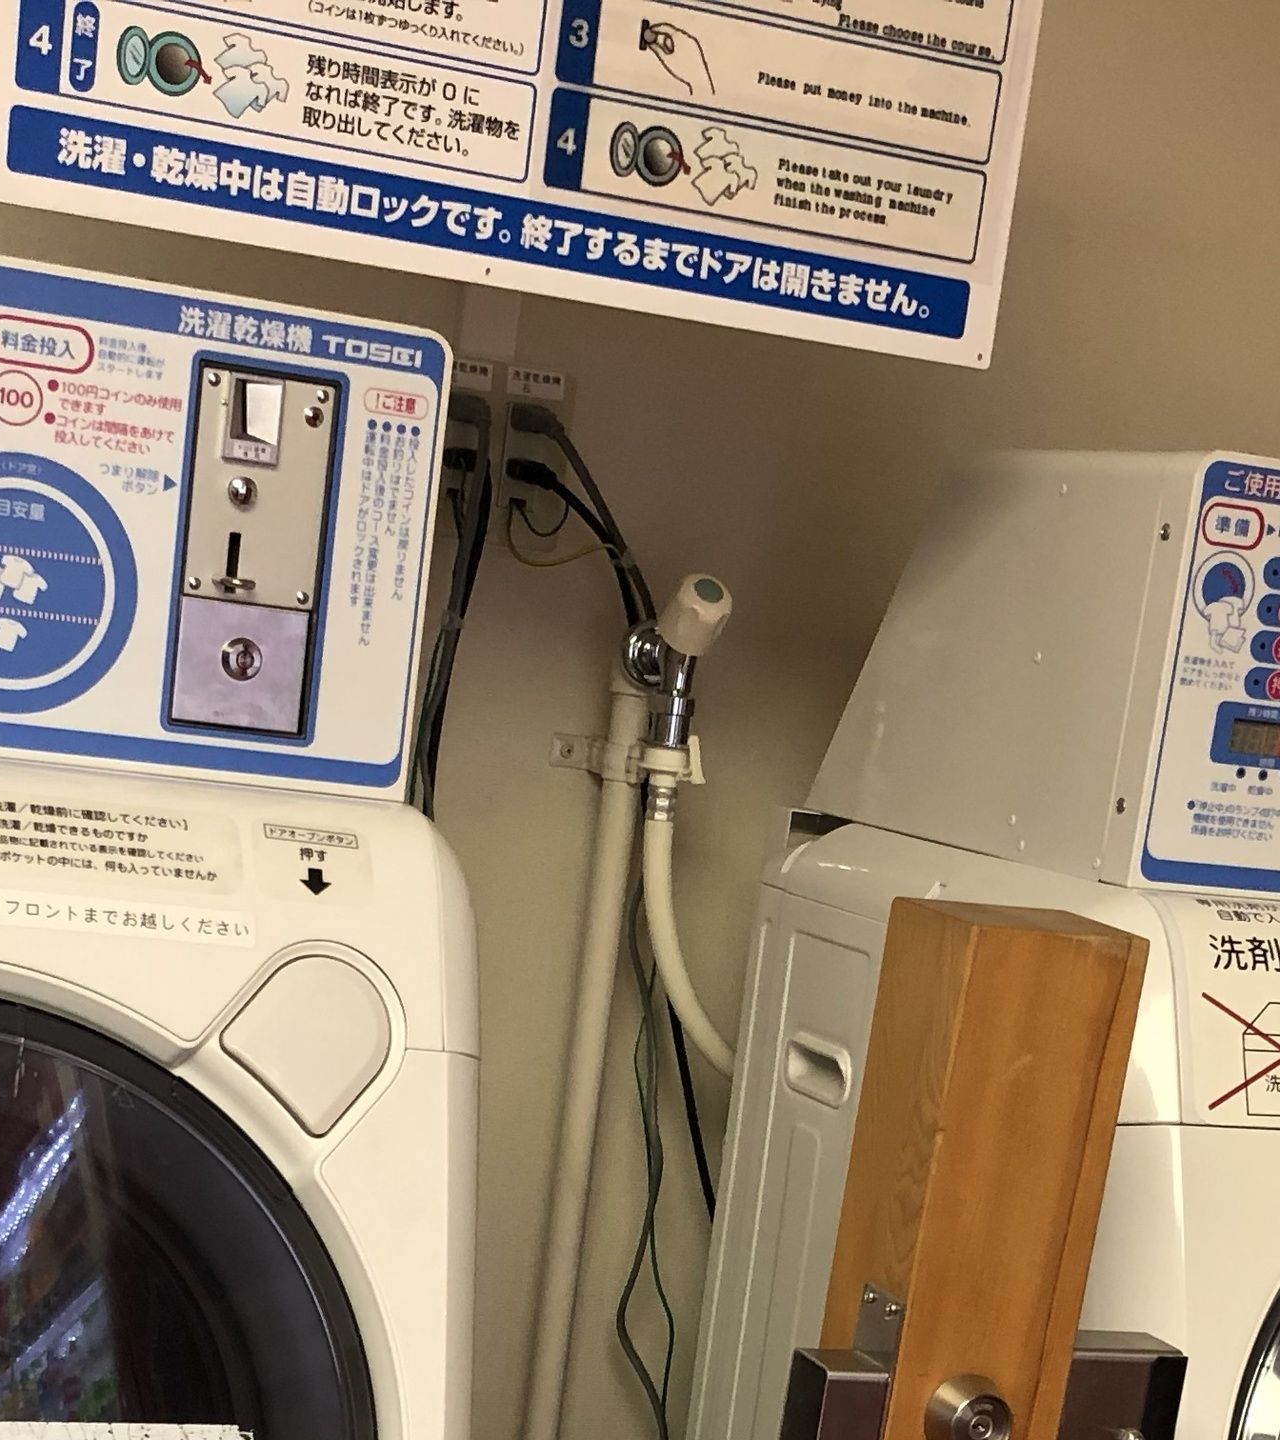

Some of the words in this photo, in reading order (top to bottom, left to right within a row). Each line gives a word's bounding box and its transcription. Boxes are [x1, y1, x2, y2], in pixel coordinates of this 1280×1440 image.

[28, 24, 52, 55] 4
[73, 11, 97, 80] 終了
[568, 20, 589, 48] 3
[838, 13, 880, 33] Please
[883, 25, 924, 43] choose
[926, 32, 947, 48] the
[307, 54, 437, 96] 残り時間表示が
[758, 70, 796, 91] Please
[803, 81, 822, 96] put
[827, 87, 862, 105] money
[868, 95, 893, 111] into
[898, 101, 918, 115] the
[921, 106, 971, 127] machine.
[302, 106, 470, 157] 取り出してください。
[556, 127, 578, 155] 4
[776, 176, 806, 193] when
[810, 182, 830, 197] the
[834, 187, 882, 208] washing
[889, 197, 936, 217] machine
[778, 158, 819, 177] Please
[822, 167, 849, 182] take
[853, 174, 872, 187] out
[876, 178, 902, 193] your
[907, 183, 953, 204] laundry
[773, 192, 811, 212] finish
[815, 200, 836, 216] the
[1, 328, 76, 360] 料金投入
[178, 305, 313, 354] 洗濯乾燥機
[322, 334, 423, 368] TOSEI
[60, 399, 107, 416] できます
[61, 381, 183, 412] 100円コインのみ使用
[55, 430, 151, 455] 投入してください
[122, 481, 159, 495] ボタン
[1214, 513, 1251, 537] 準備
[299, 847, 327, 863] 押す
